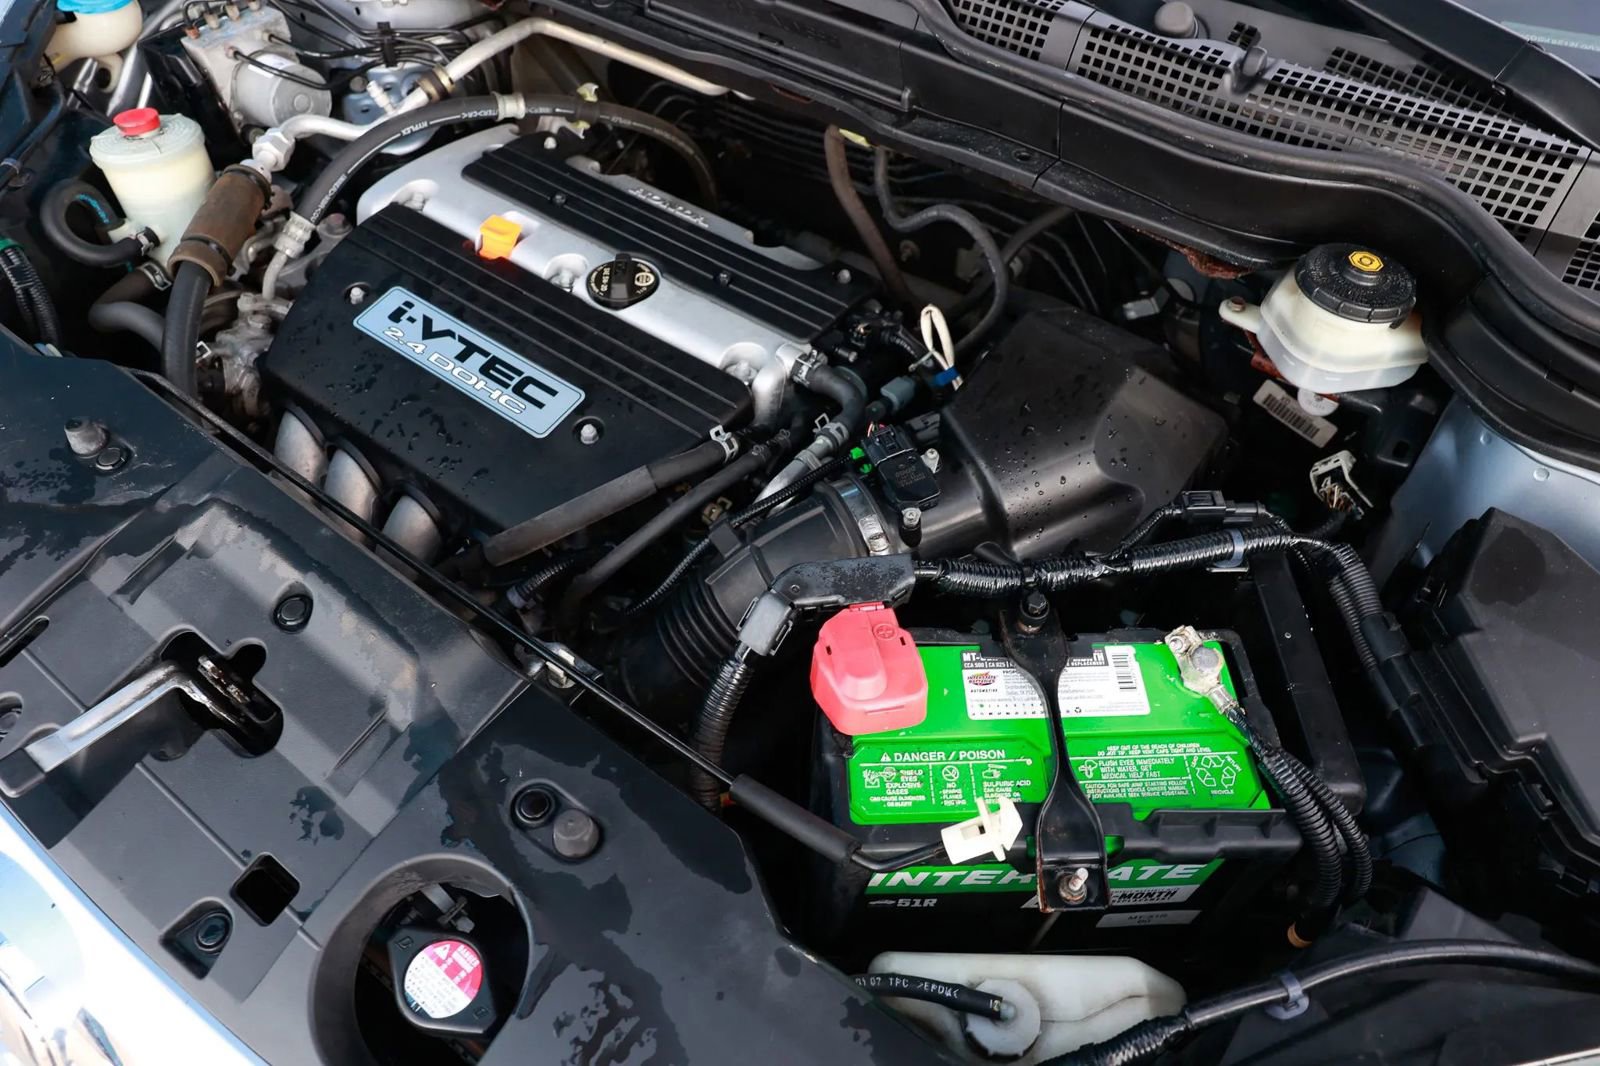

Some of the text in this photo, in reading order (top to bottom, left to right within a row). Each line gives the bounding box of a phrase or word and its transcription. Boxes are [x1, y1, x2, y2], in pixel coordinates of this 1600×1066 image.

[383, 327, 527, 414] 2.4 DOHC
[387, 300, 559, 410] i-VTEC
[893, 752, 946, 762] DANGER
[958, 749, 1006, 760] POISON
[1098, 759, 1118, 767] FLUSH
[1135, 757, 1175, 765] IMMEDIATELY
